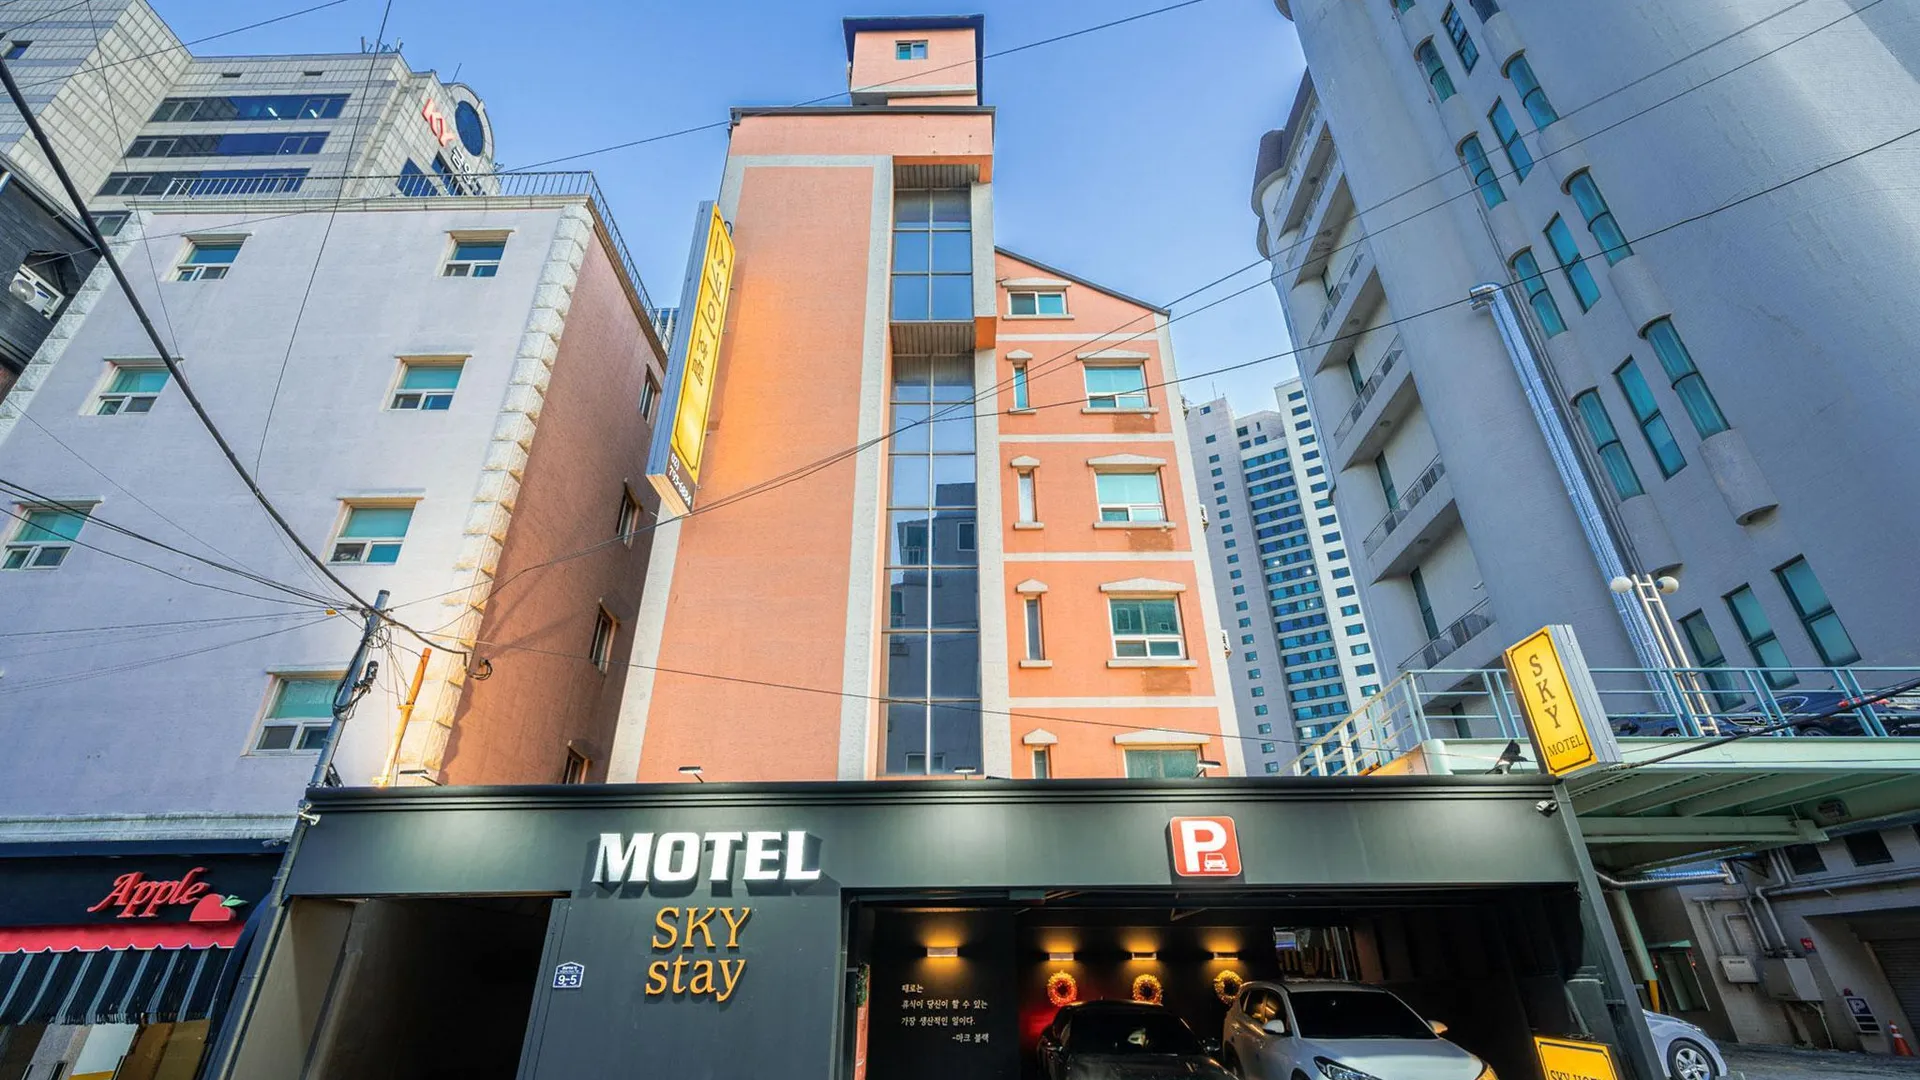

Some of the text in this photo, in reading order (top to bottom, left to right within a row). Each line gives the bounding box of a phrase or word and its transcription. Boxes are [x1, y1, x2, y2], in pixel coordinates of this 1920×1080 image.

[701, 230, 726, 340] 스카이
[1528, 653, 1562, 729] SKY
[1547, 734, 1584, 757] MOTEL
[592, 831, 821, 884] MOTEL
[1180, 820, 1227, 873] P
[86, 866, 211, 919] Apple
[652, 906, 751, 950] SKY
[557, 974, 577, 985] 9-5
[645, 954, 748, 1003] stay
[900, 1015, 916, 1027] 가장
[919, 1015, 949, 1027] 생산적인
[926, 999, 949, 1010] 당신이
[962, 999, 971, 1010] 수
[973, 999, 988, 1010] 있는
